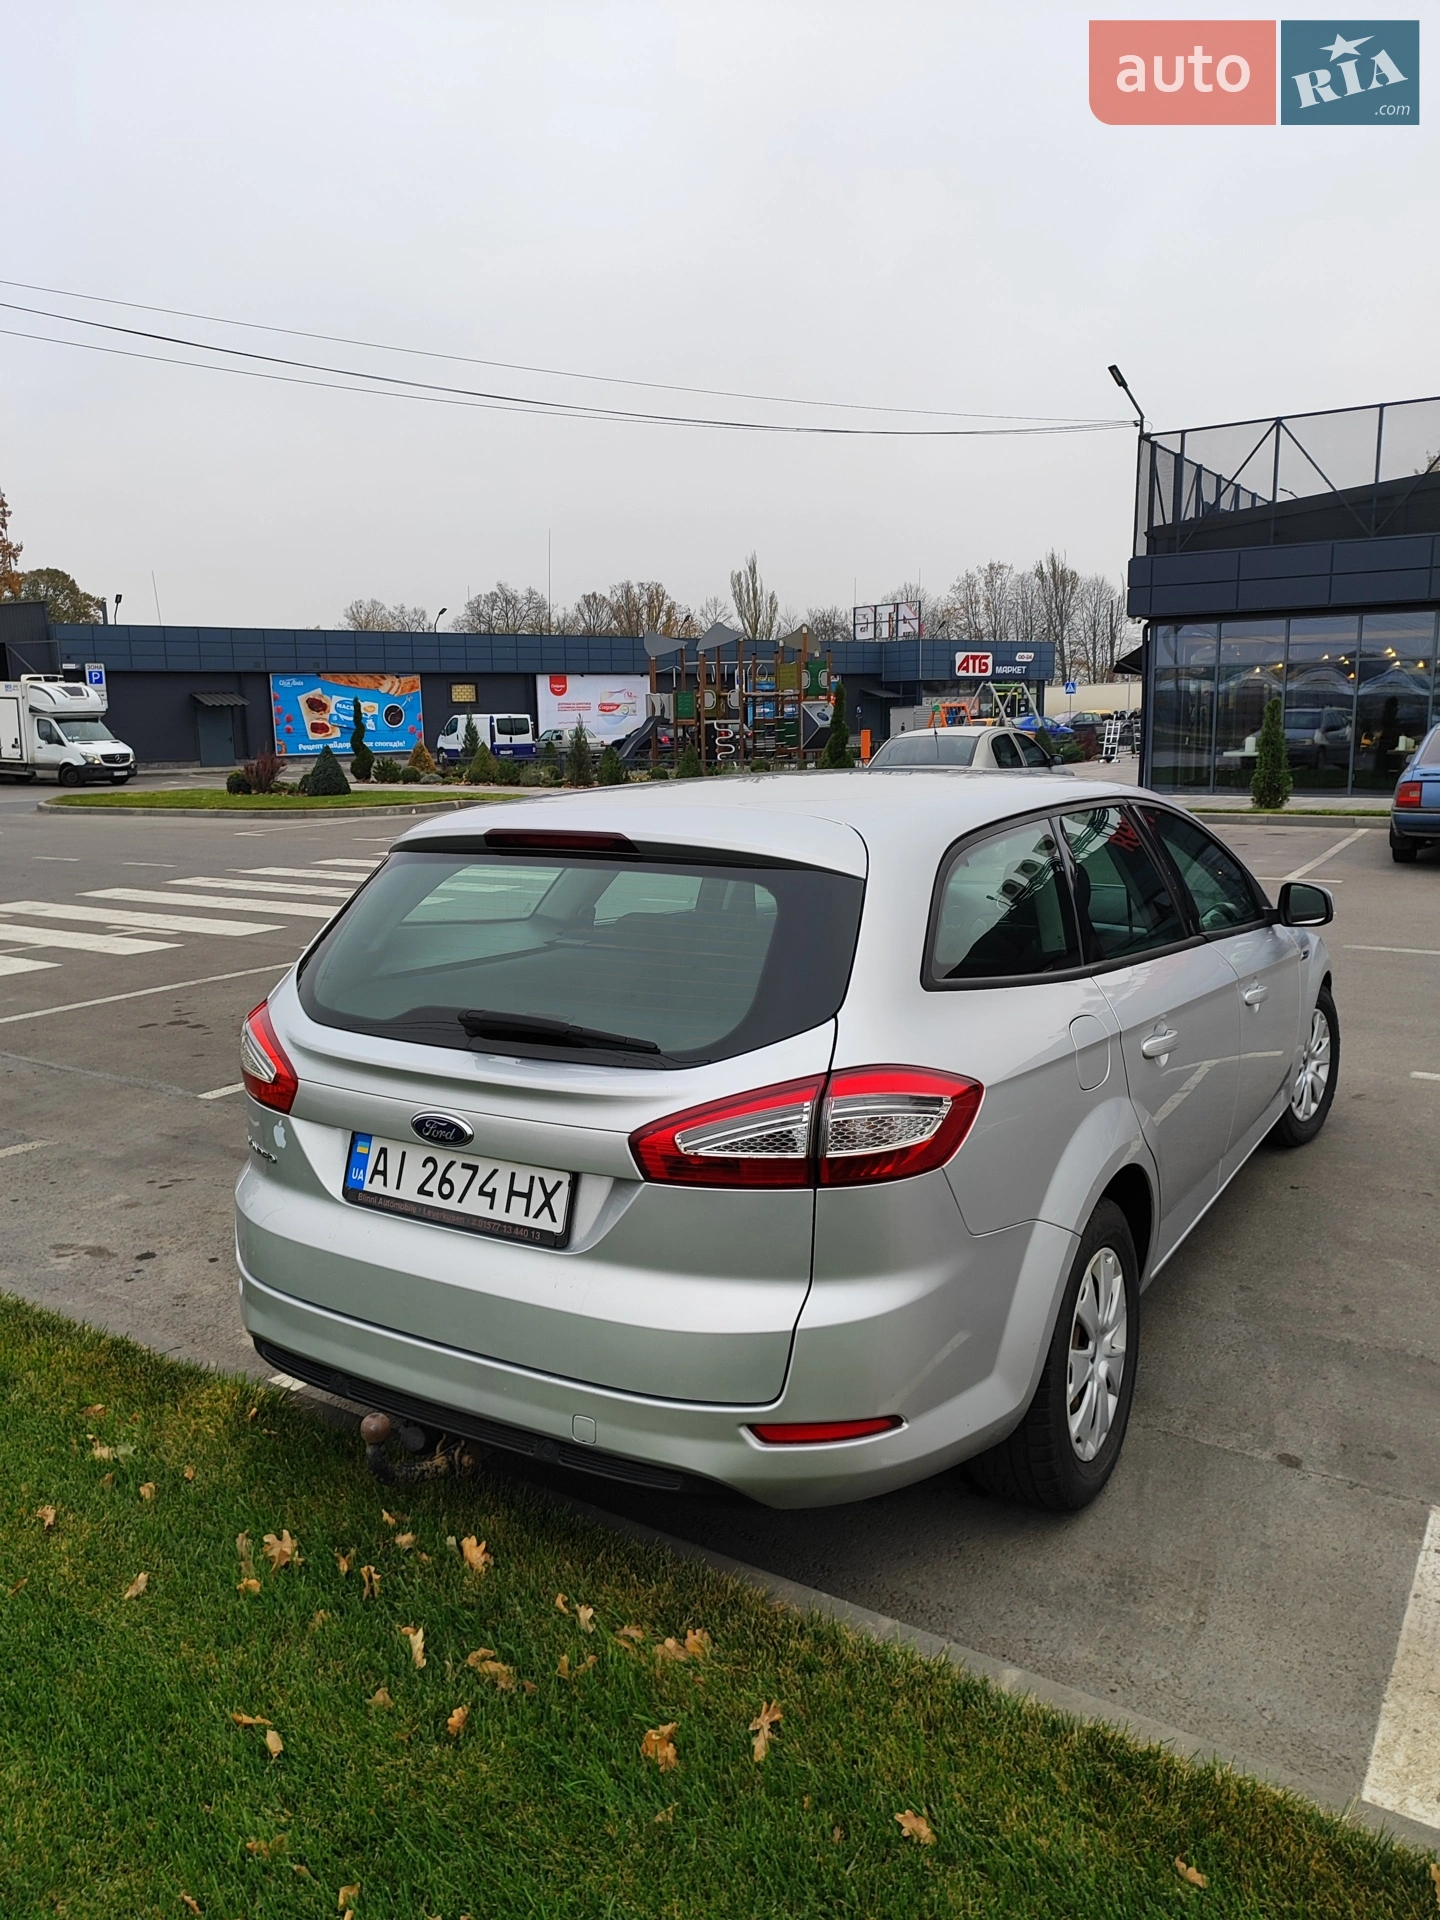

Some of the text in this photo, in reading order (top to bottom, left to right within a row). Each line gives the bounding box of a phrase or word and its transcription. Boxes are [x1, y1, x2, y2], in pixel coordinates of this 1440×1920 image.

[957, 654, 991, 674] АТБ
[995, 665, 1027, 674] МАРКЕТ
[336, 702, 355, 711] МАСЛ
[422, 1119, 456, 1141] Ford
[352, 1167, 364, 1181] UA
[368, 1146, 564, 1223] AI 2674 HX
[378, 1194, 417, 1214] Automobile
[422, 1208, 465, 1224] Leverkusen
[503, 1225, 513, 1234] 13
[513, 1227, 529, 1238] 440
[530, 1230, 541, 1240] 13
